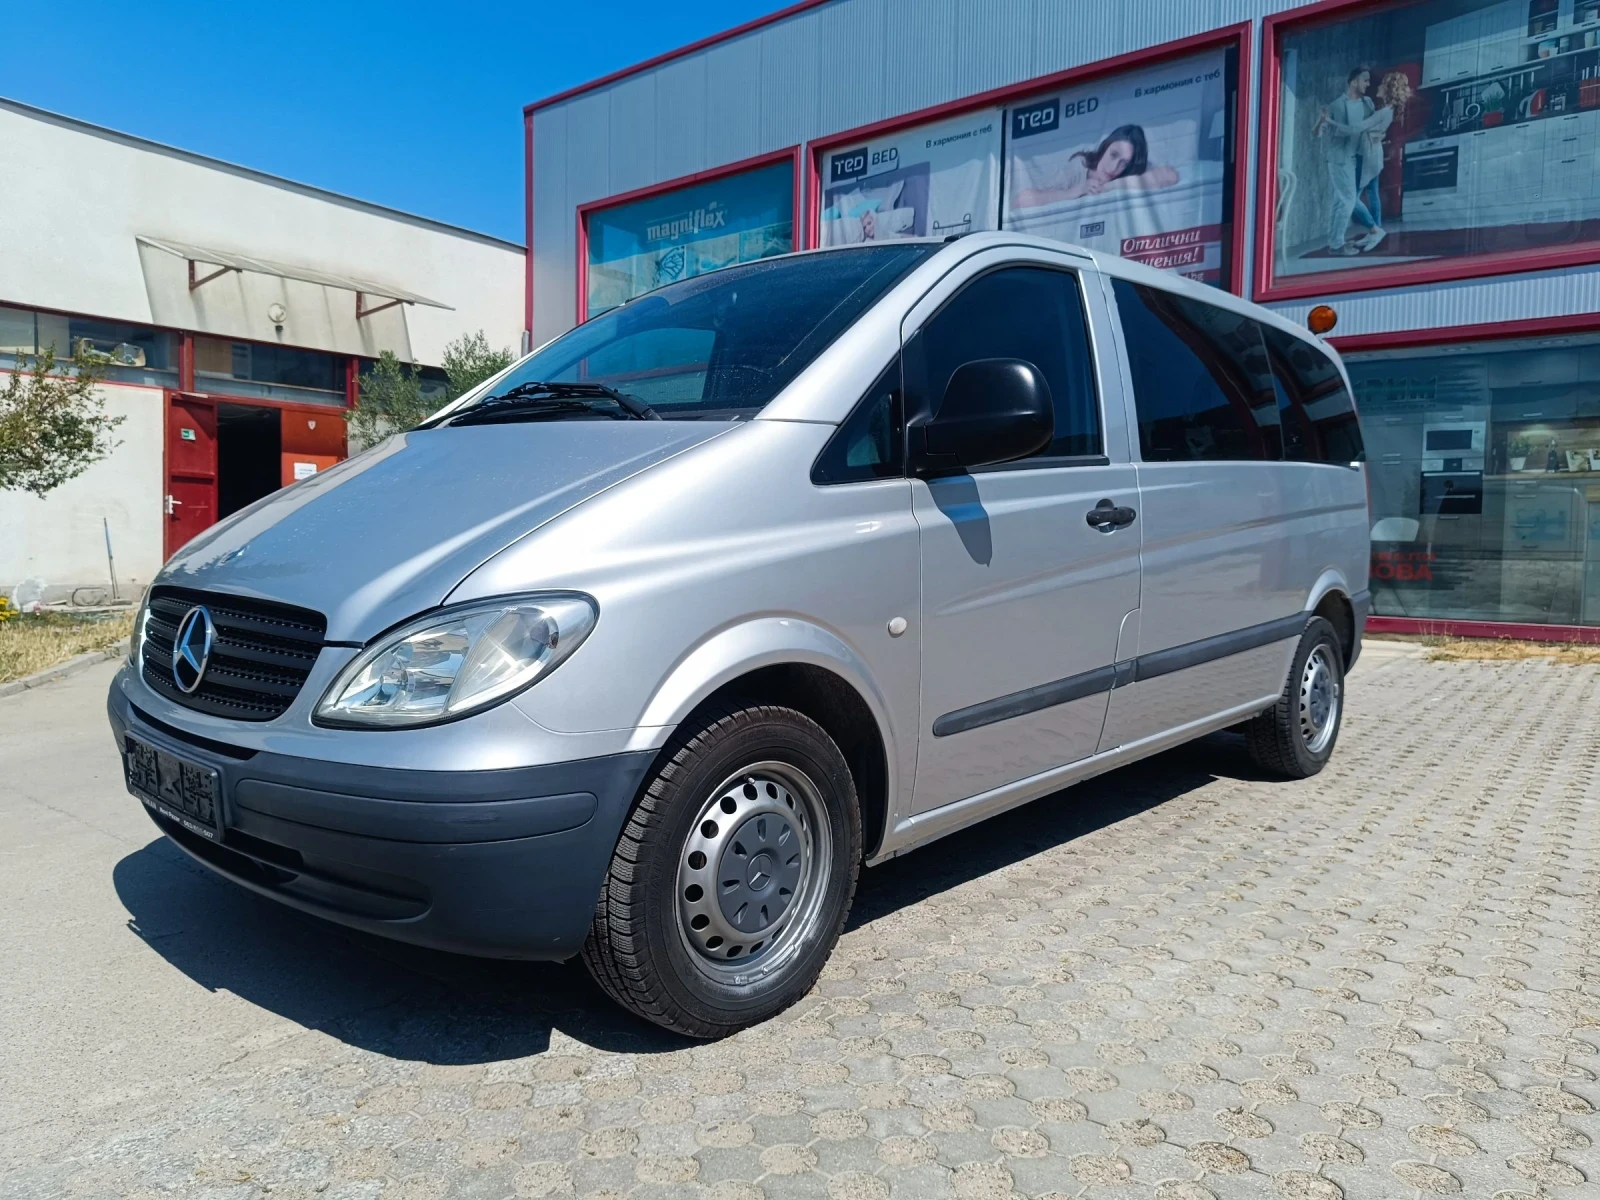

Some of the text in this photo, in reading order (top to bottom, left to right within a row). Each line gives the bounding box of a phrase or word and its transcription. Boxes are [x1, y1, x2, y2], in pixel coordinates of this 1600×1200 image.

[1144, 77, 1193, 96] хармония
[1204, 68, 1220, 81] теб
[1064, 97, 1099, 118] BED
[933, 131, 972, 146] хармония
[871, 147, 898, 166] BED
[647, 208, 725, 241] magniflex
[1123, 230, 1200, 253] Отлични
